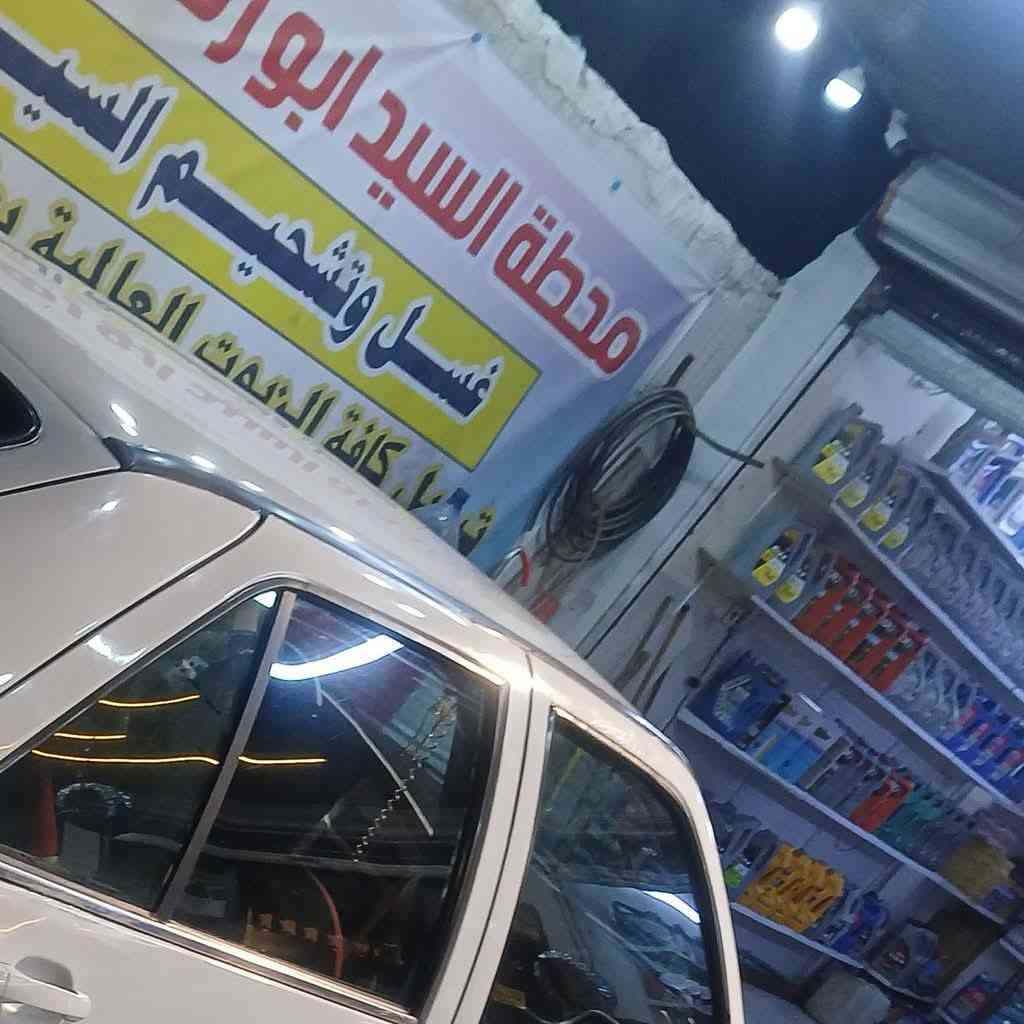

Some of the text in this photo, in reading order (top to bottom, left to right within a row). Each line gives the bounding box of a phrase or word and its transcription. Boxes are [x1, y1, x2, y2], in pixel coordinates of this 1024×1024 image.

[243, 12, 383, 132] ابو
[349, 90, 523, 255] السيد
[136, 150, 377, 343] وتشحيم
[493, 204, 642, 375] محطة
[365, 304, 499, 417] غسل
[325, 406, 407, 486] كافة
